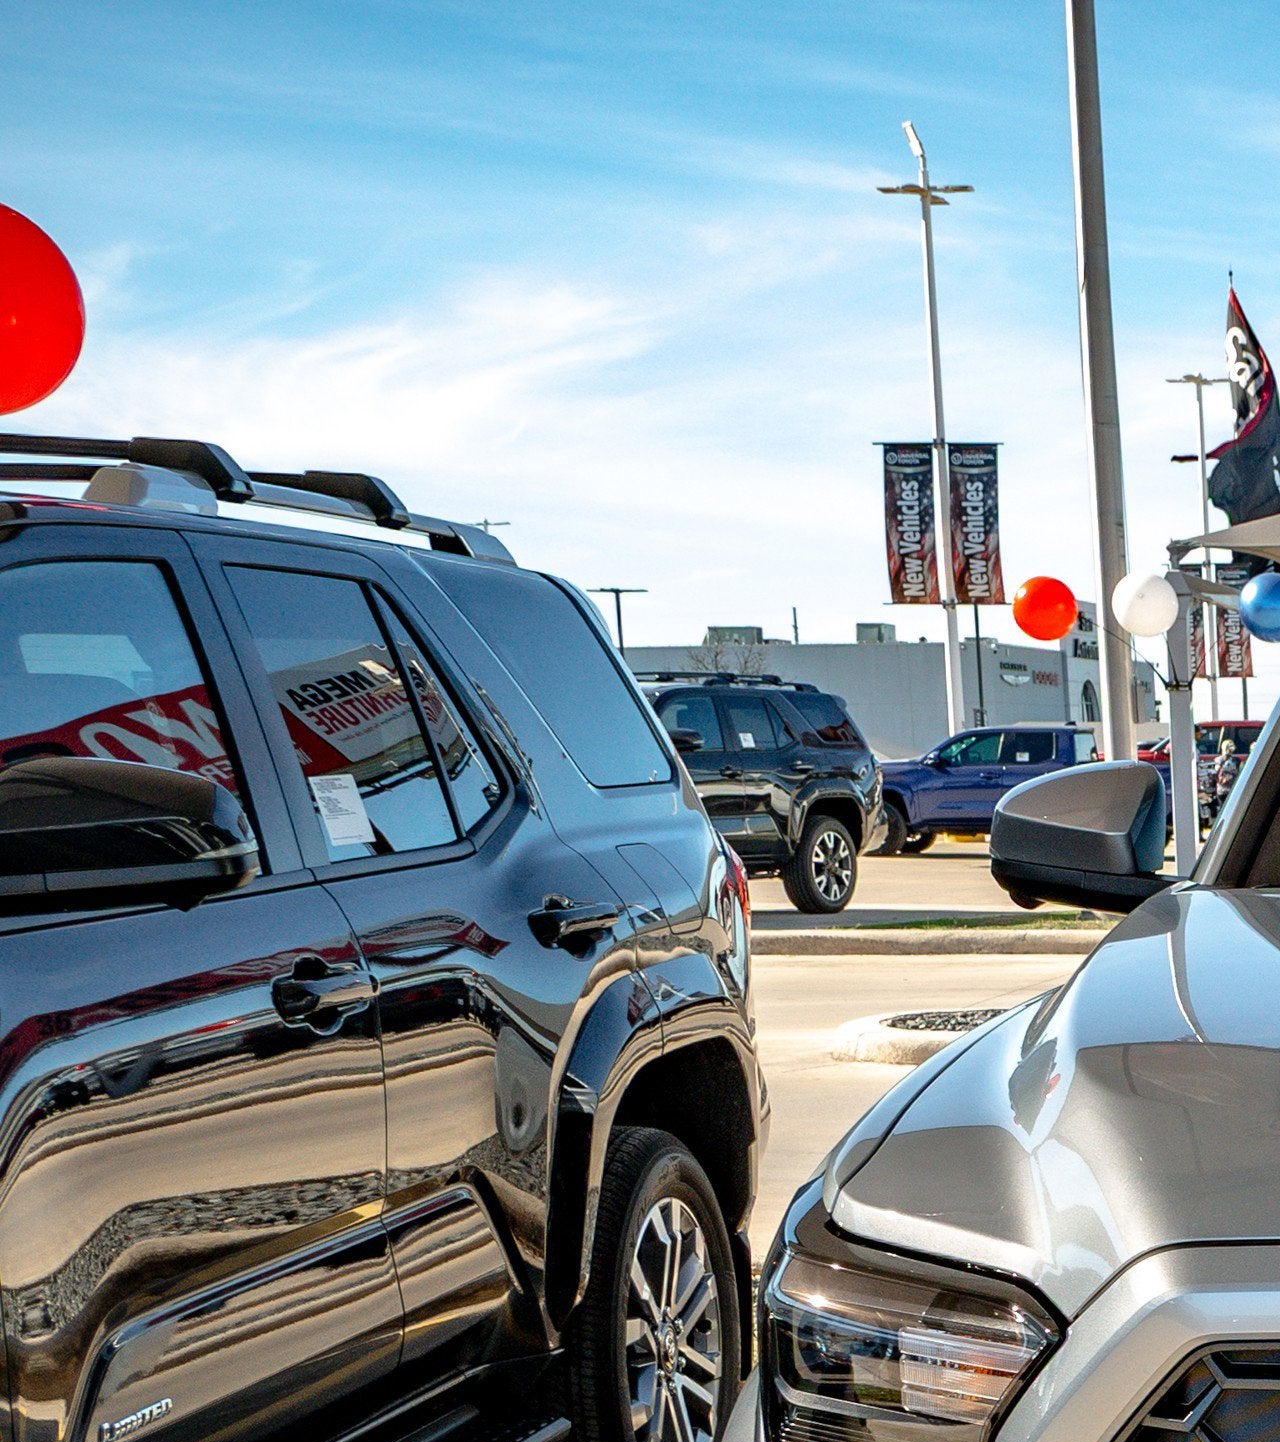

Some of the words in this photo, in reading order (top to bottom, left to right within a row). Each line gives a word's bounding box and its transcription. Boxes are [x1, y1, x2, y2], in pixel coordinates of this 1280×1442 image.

[897, 480, 921, 555] Vehicles
[961, 481, 984, 556] Vehicles
[902, 557, 925, 597] New
[967, 558, 990, 598] New
[1227, 643, 1242, 673] New
